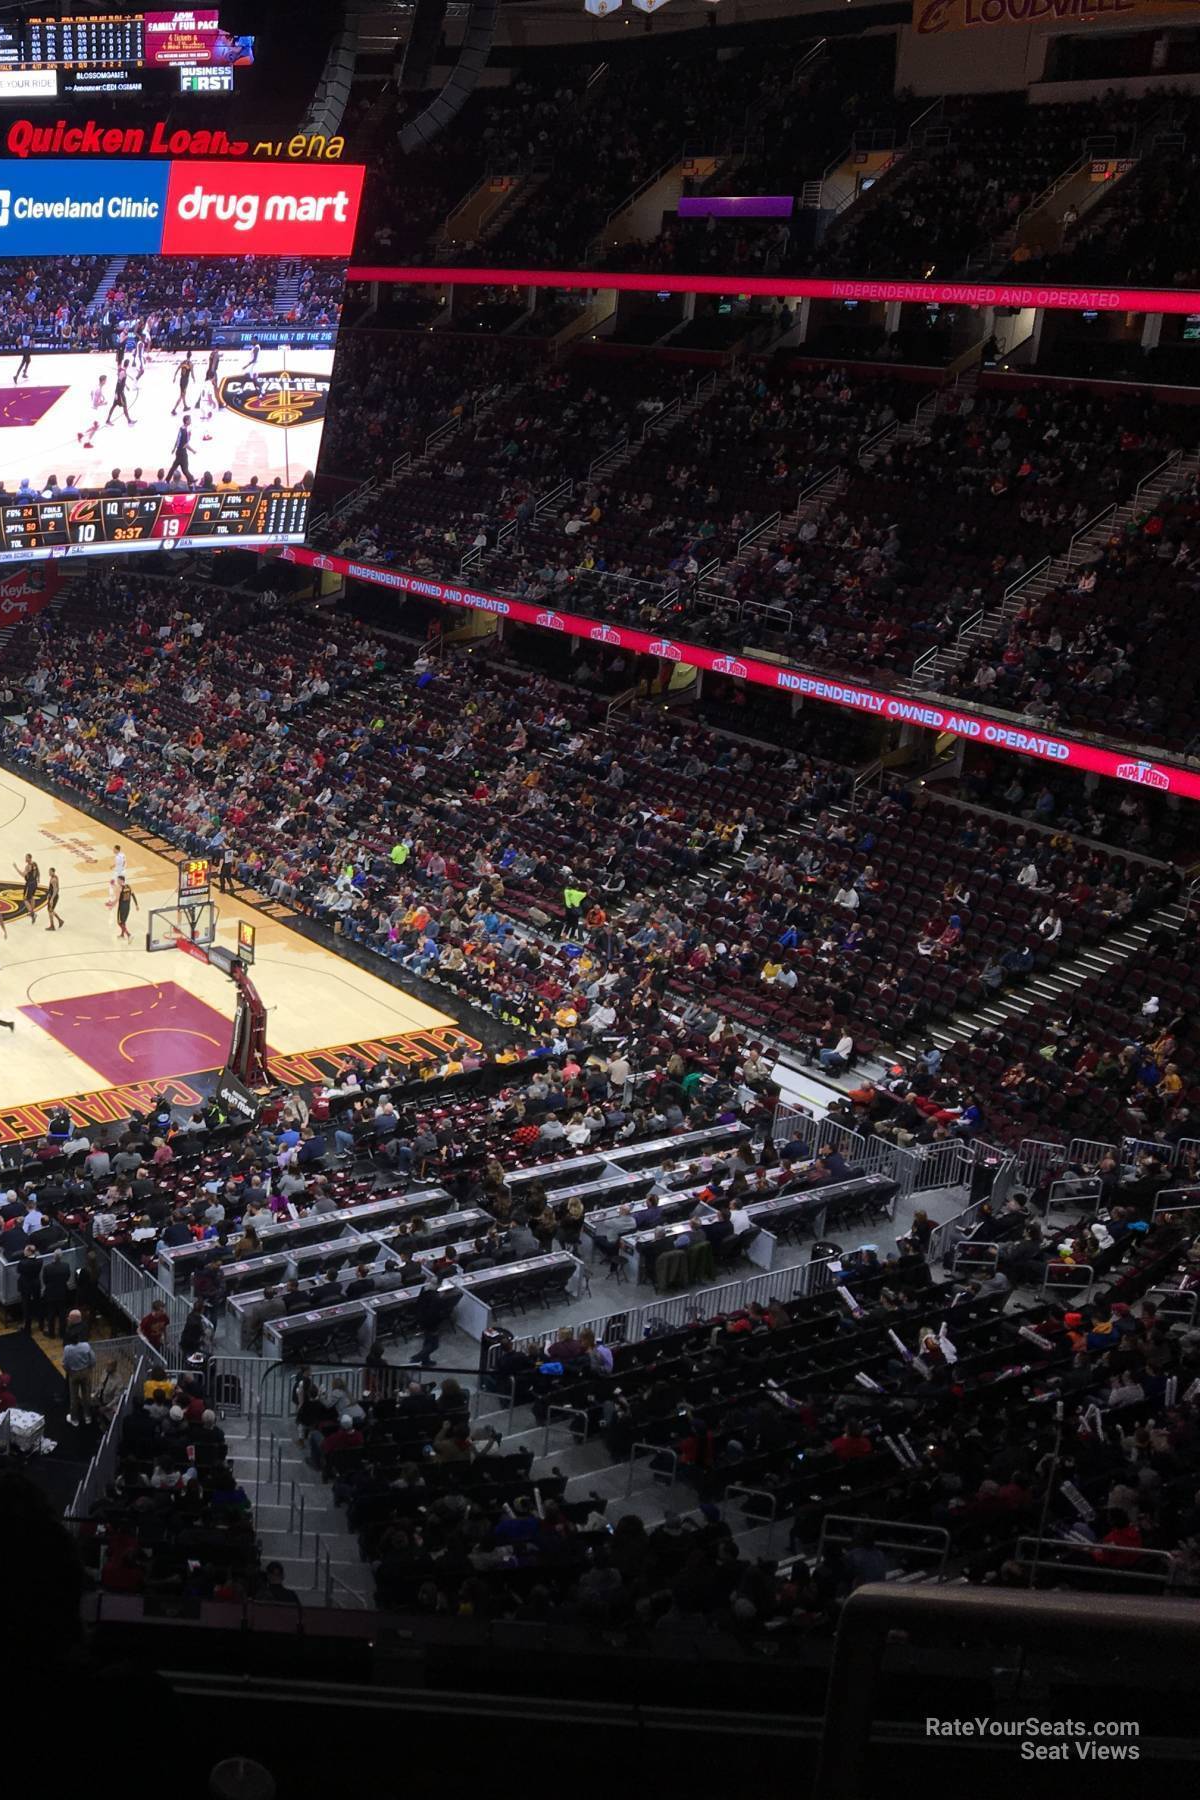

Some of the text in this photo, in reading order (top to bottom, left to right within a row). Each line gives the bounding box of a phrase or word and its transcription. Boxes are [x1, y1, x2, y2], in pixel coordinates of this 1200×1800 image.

[182, 66, 232, 76] BUSINESS
[182, 76, 232, 91] FIRST
[7, 120, 145, 157] Quicken
[13, 197, 160, 219] Cleveland Clinic
[177, 185, 350, 230] drug mart
[832, 283, 1120, 308] INDEPENDENTLY OWNED AND OPERATED
[144, 501, 157, 512] 13
[201, 496, 219, 504] FOULS
[227, 495, 255, 504] FG% 47
[6, 508, 34, 518] FG% 24
[43, 506, 62, 514] FOULS
[106, 502, 119, 516] 1Q
[203, 511, 211, 521] 0
[221, 509, 251, 520] 3PT% 33
[5, 522, 37, 533] 3PT% 50
[48, 521, 56, 531] 2
[162, 518, 180, 537] 19
[216, 524, 244, 534] TOL 7
[78, 524, 96, 543] 10
[113, 526, 144, 541] 3:37
[10, 538, 37, 548] TOL 6
[348, 564, 510, 615] INDEPENDENTLY OWNED AND OPERATED
[776, 672, 1070, 760] INDEPENDENTLY OWNED AND OPERATED
[1117, 765, 1140, 781] PAPA
[266, 1027, 484, 1087] CLEVELAN
